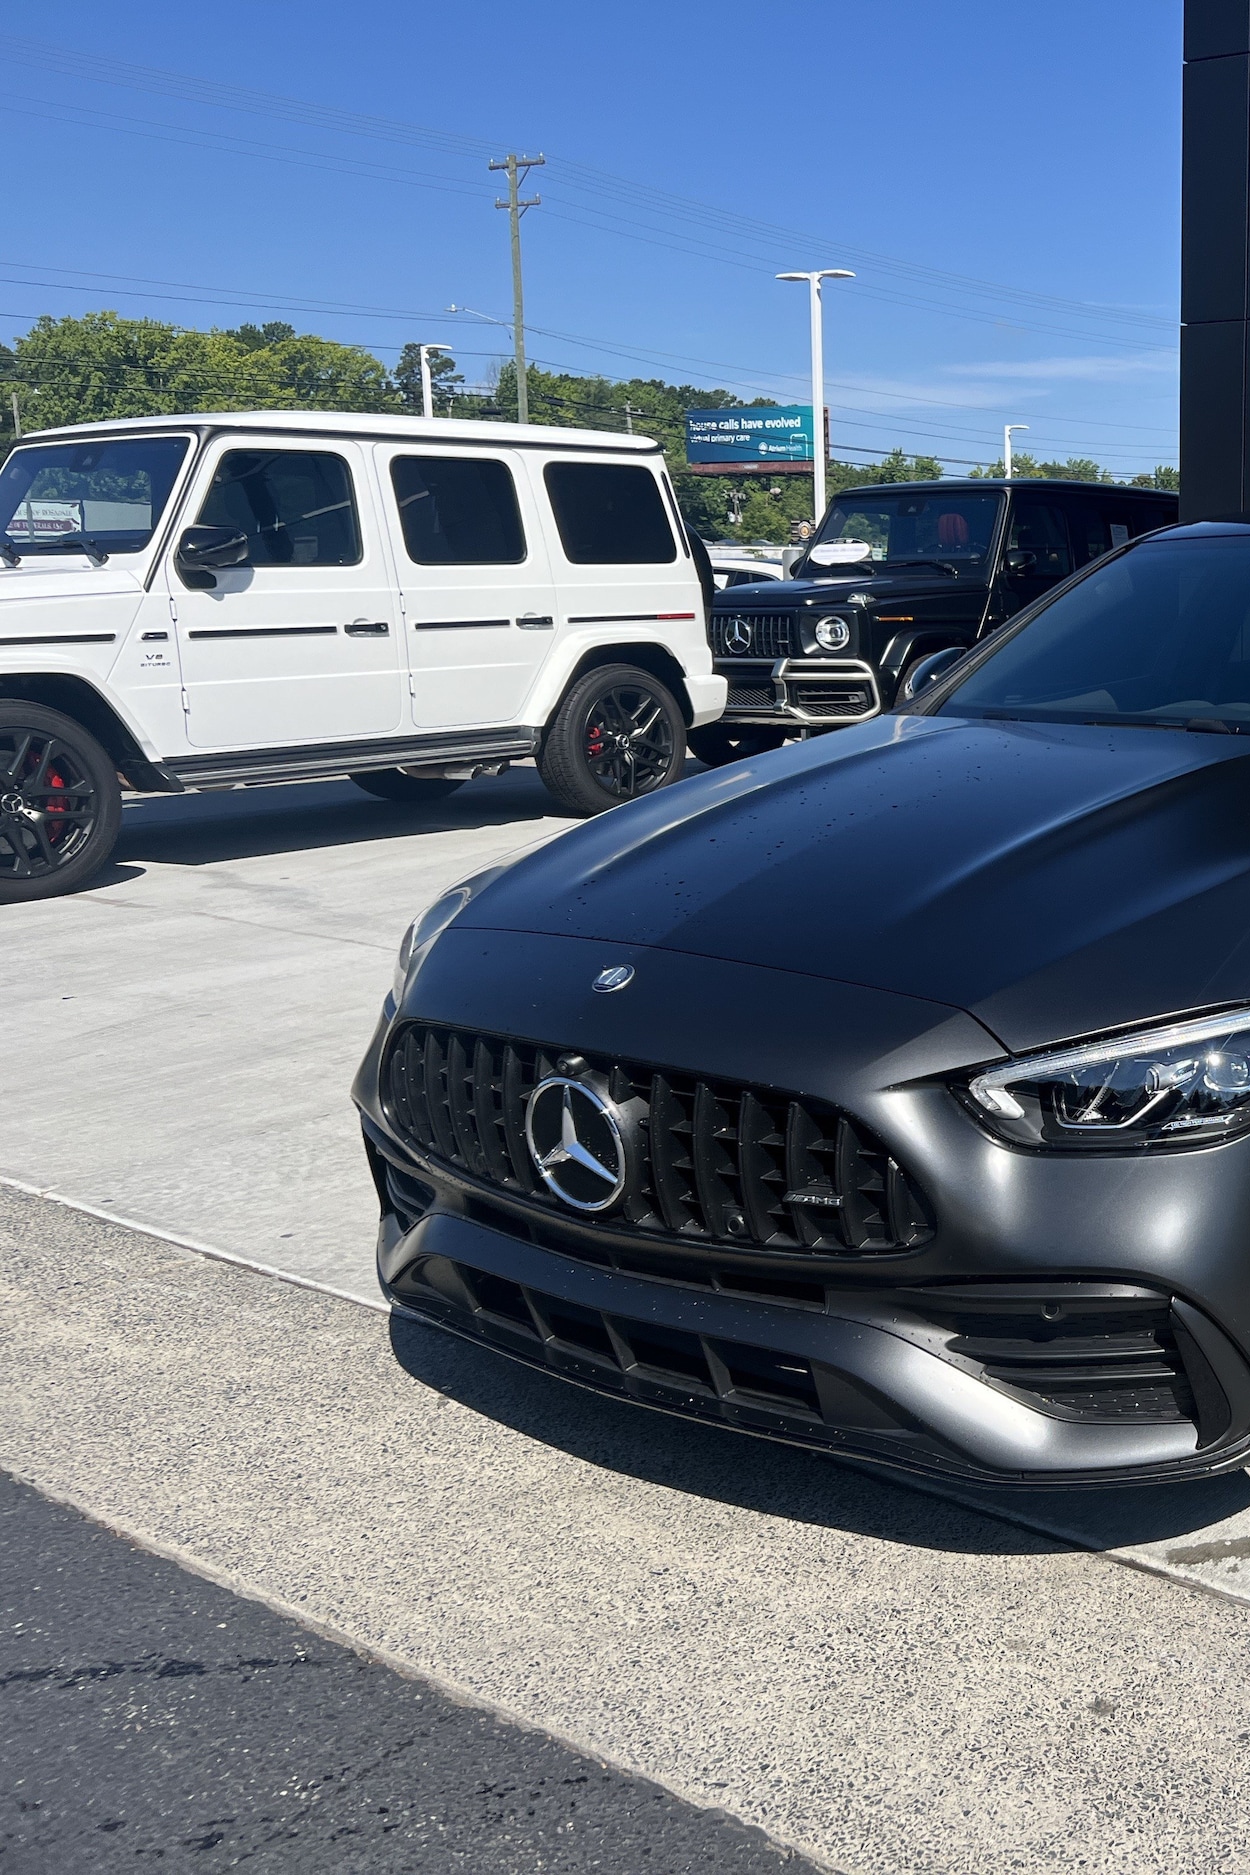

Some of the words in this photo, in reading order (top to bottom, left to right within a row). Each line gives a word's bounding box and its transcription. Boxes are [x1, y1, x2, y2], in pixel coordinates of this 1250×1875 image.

[690, 420, 717, 431] house
[719, 418, 739, 430] calls
[741, 418, 763, 430] have
[765, 416, 801, 429] evolved
[690, 434, 710, 443] virtual
[711, 434, 735, 443] primary
[736, 434, 750, 442] care
[795, 1194, 841, 1206] AMG
